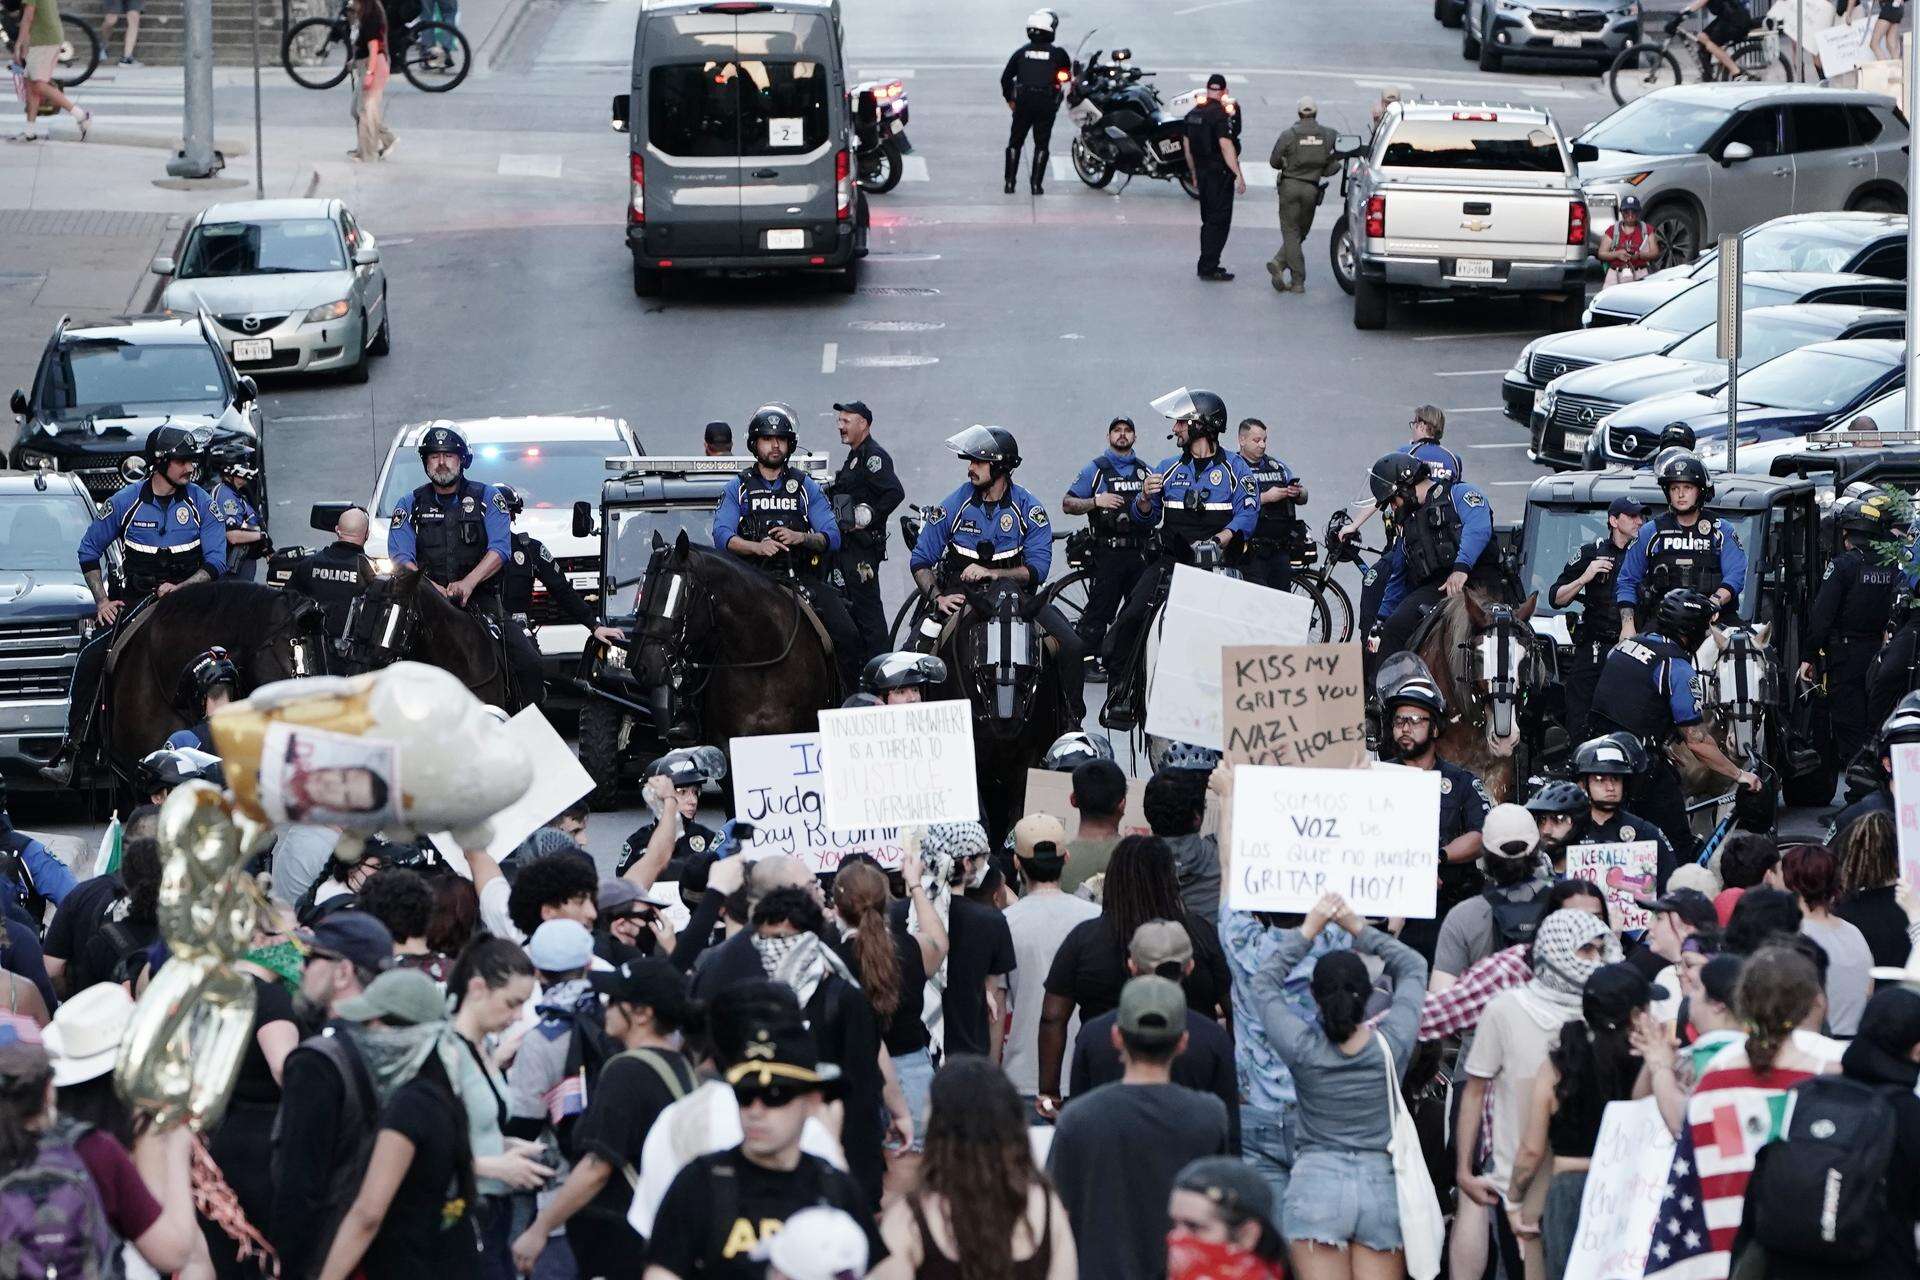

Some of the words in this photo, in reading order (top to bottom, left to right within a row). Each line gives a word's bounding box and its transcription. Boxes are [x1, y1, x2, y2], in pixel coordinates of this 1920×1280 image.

[782, 129, 789, 141] 2
[1114, 481, 1143, 491] POLIC
[1253, 471, 1283, 482] POLICE
[752, 496, 798, 511] POLICE
[1663, 535, 1711, 551] POLICE
[311, 567, 358, 583] POLICE
[1863, 573, 1891, 584] POLIC
[192, 657, 211, 673] POLICE
[1235, 654, 1297, 687] KISS
[1305, 654, 1340, 676] MY
[1236, 688, 1308, 712] GRITS
[1317, 685, 1358, 701] YOU
[905, 705, 967, 736] ANYWHERE
[1228, 715, 1299, 751] NAZI
[1294, 723, 1366, 763] HOLES
[850, 742, 860, 759] IS
[865, 743, 874, 759] A
[879, 738, 924, 760] THREAT
[929, 737, 942, 759] TO
[836, 760, 945, 800] JUSTICE
[747, 786, 826, 823] Judg
[1272, 792, 1349, 813] SOMOS
[1368, 795, 1394, 813] LA
[1290, 815, 1341, 839] VOZ
[751, 826, 796, 854] Day
[1244, 865, 1328, 895] GRITAR
[1350, 873, 1404, 900] HOY!
